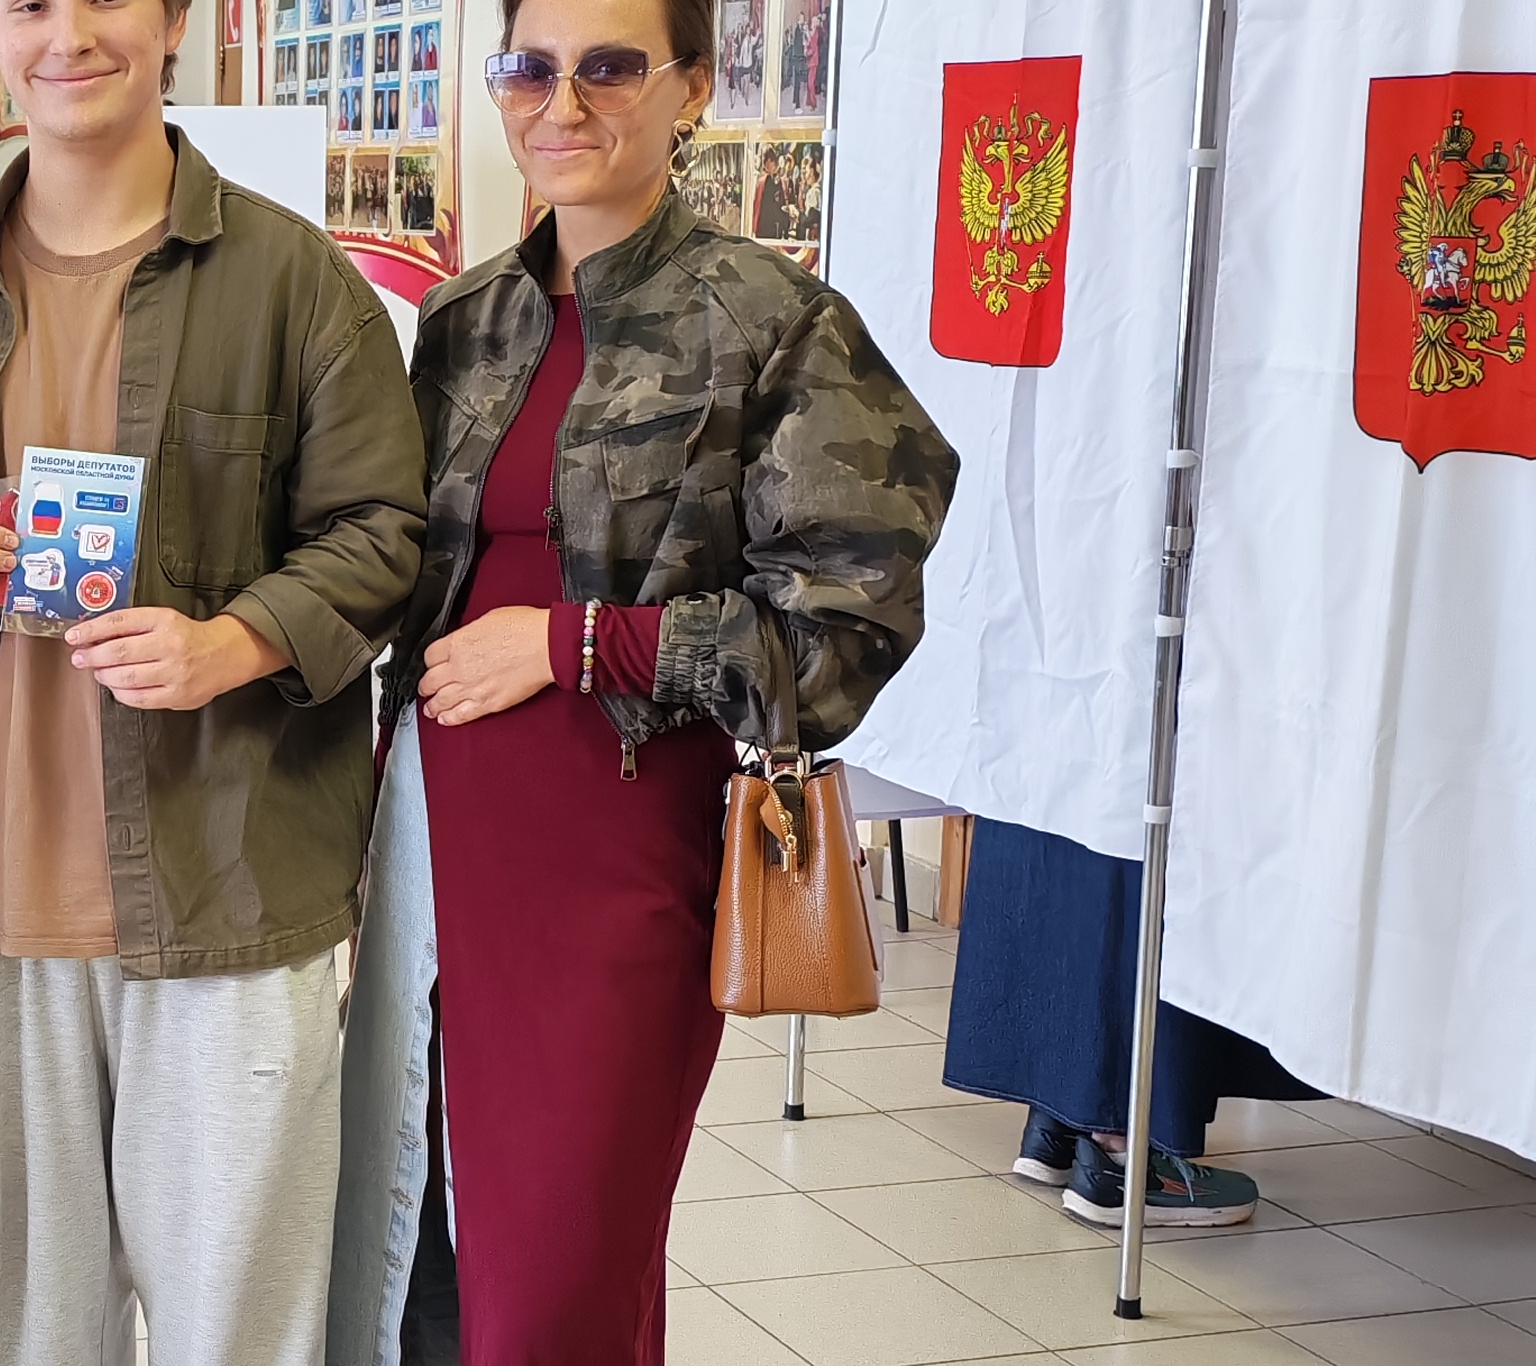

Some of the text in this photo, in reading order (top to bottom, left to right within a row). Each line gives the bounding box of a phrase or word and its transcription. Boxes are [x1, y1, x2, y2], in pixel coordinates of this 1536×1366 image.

[31, 455, 136, 474] ВЫБОРЫ ДЕПУТАТОВ
[31, 466, 135, 481] МОСКОВСКОЙ ОБЛАСТНОЙ ДУМЫ
